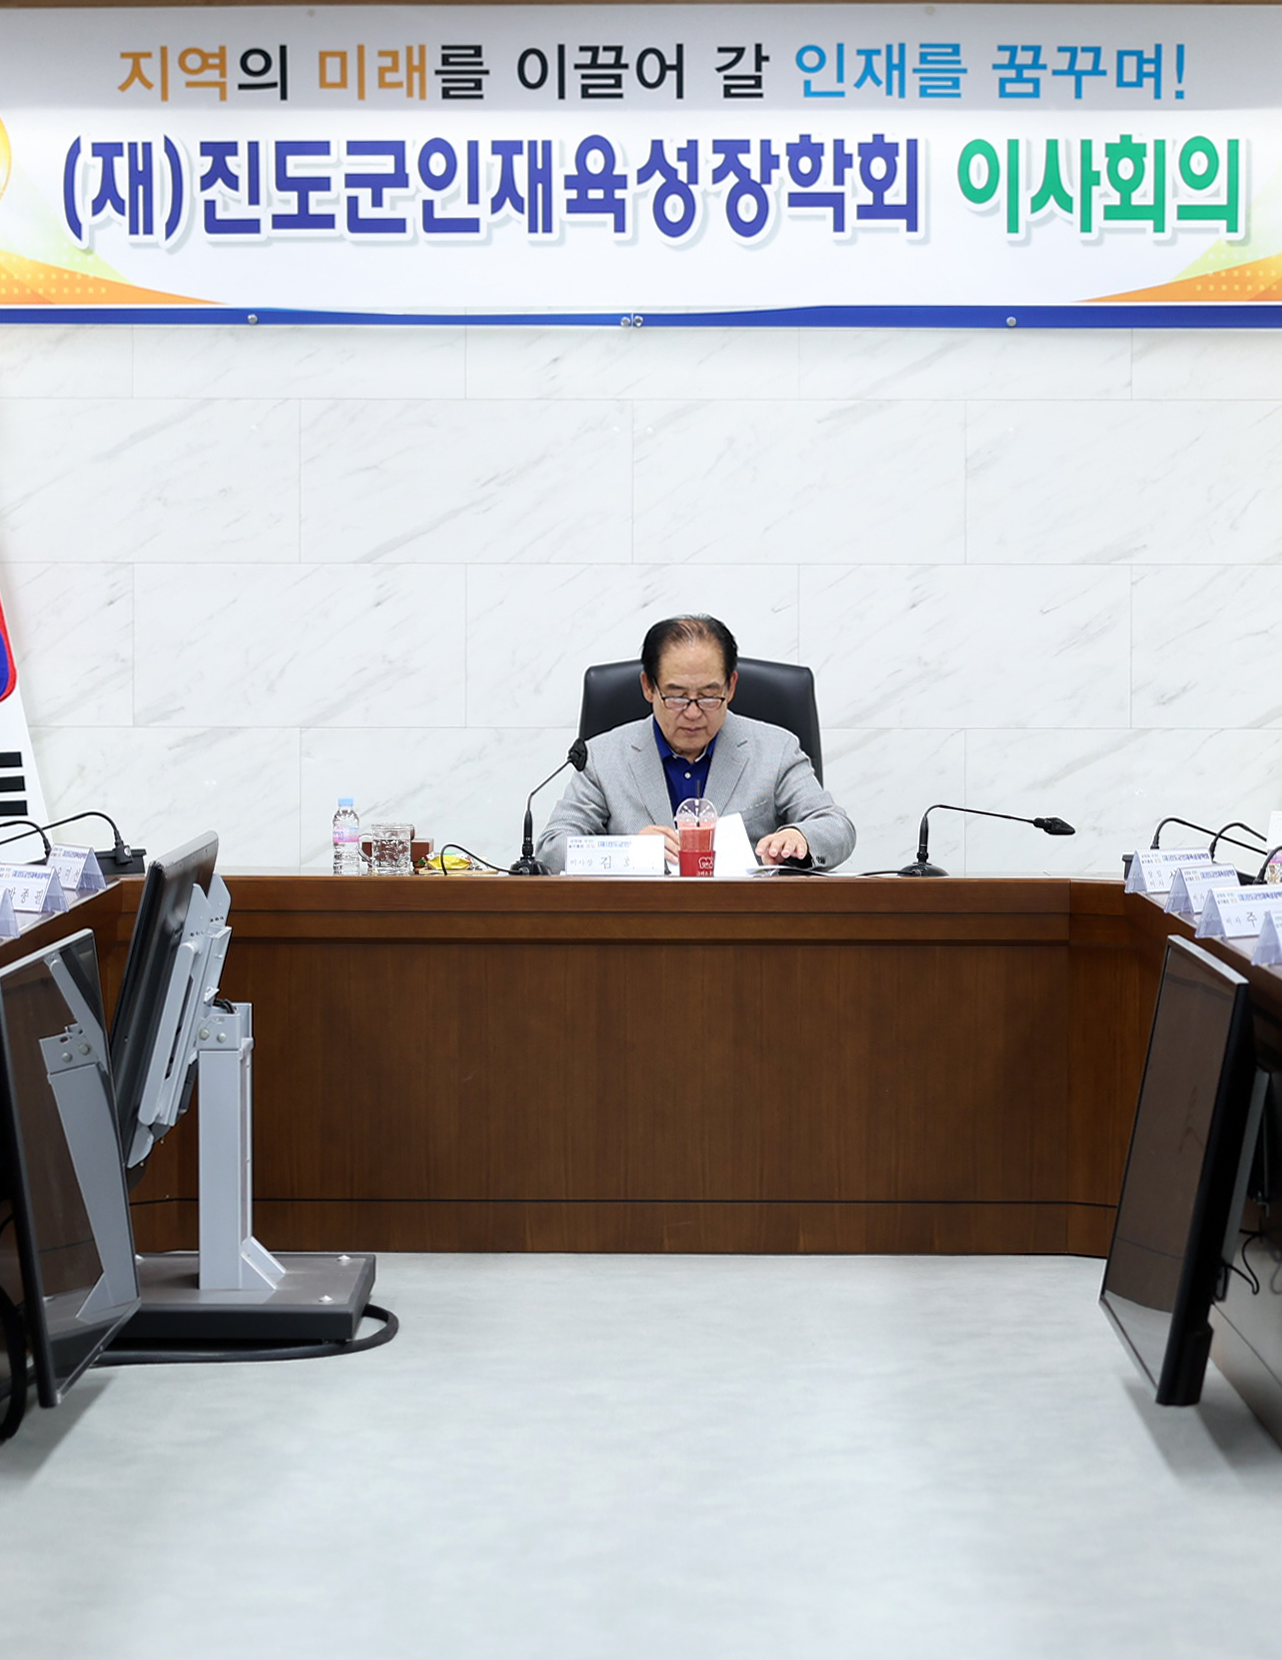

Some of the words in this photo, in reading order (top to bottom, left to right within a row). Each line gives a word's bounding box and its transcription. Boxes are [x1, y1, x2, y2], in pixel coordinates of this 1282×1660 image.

[117, 43, 289, 102] 지역의
[318, 43, 490, 102] 미래를
[519, 43, 686, 101] 이끌어
[715, 43, 770, 100] 갈
[793, 43, 968, 100] 인재를
[991, 43, 1186, 101] 꿈꾸며!
[62, 133, 920, 241] (재)진도군인재육성장학회
[957, 133, 1240, 235] 이사회의
